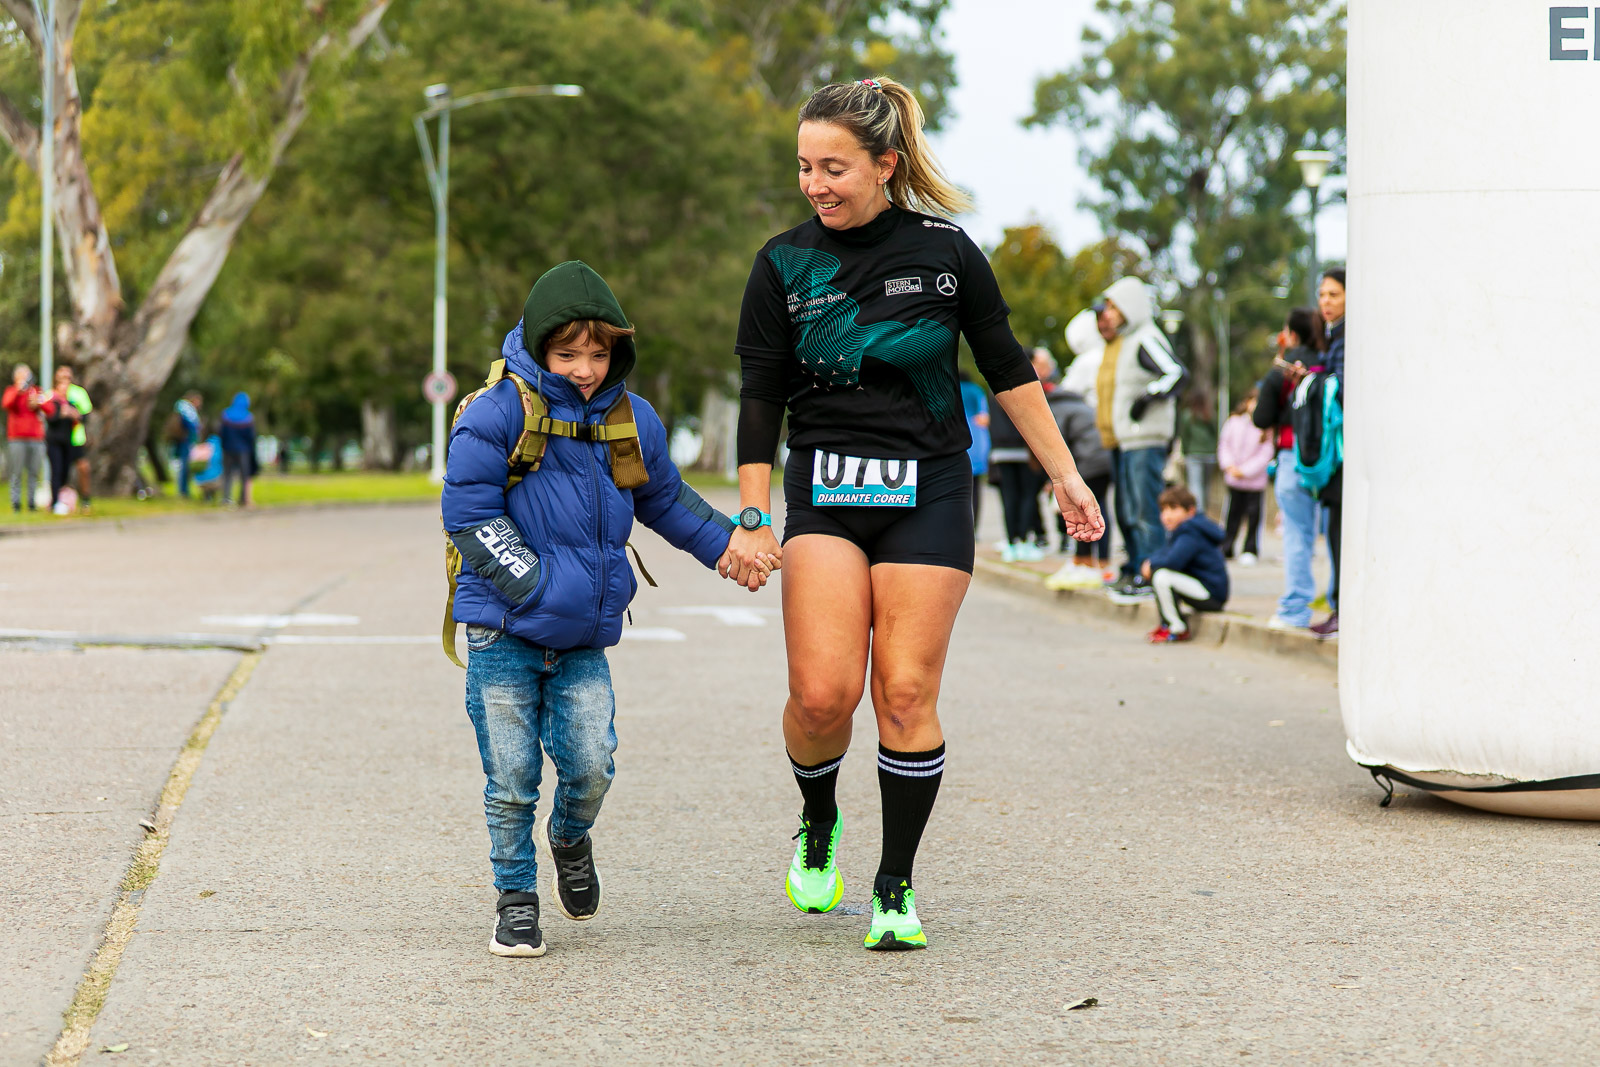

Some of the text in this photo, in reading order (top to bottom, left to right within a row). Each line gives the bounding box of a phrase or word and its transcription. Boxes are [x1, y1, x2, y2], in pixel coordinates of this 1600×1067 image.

[888, 280, 910, 289] STERN
[888, 284, 920, 294] MOTORS
[821, 450, 907, 489] 070
[817, 493, 910, 504] DIAMANTE CORRE
[475, 525, 531, 579] BATIC
[490, 518, 539, 568] BATIC
